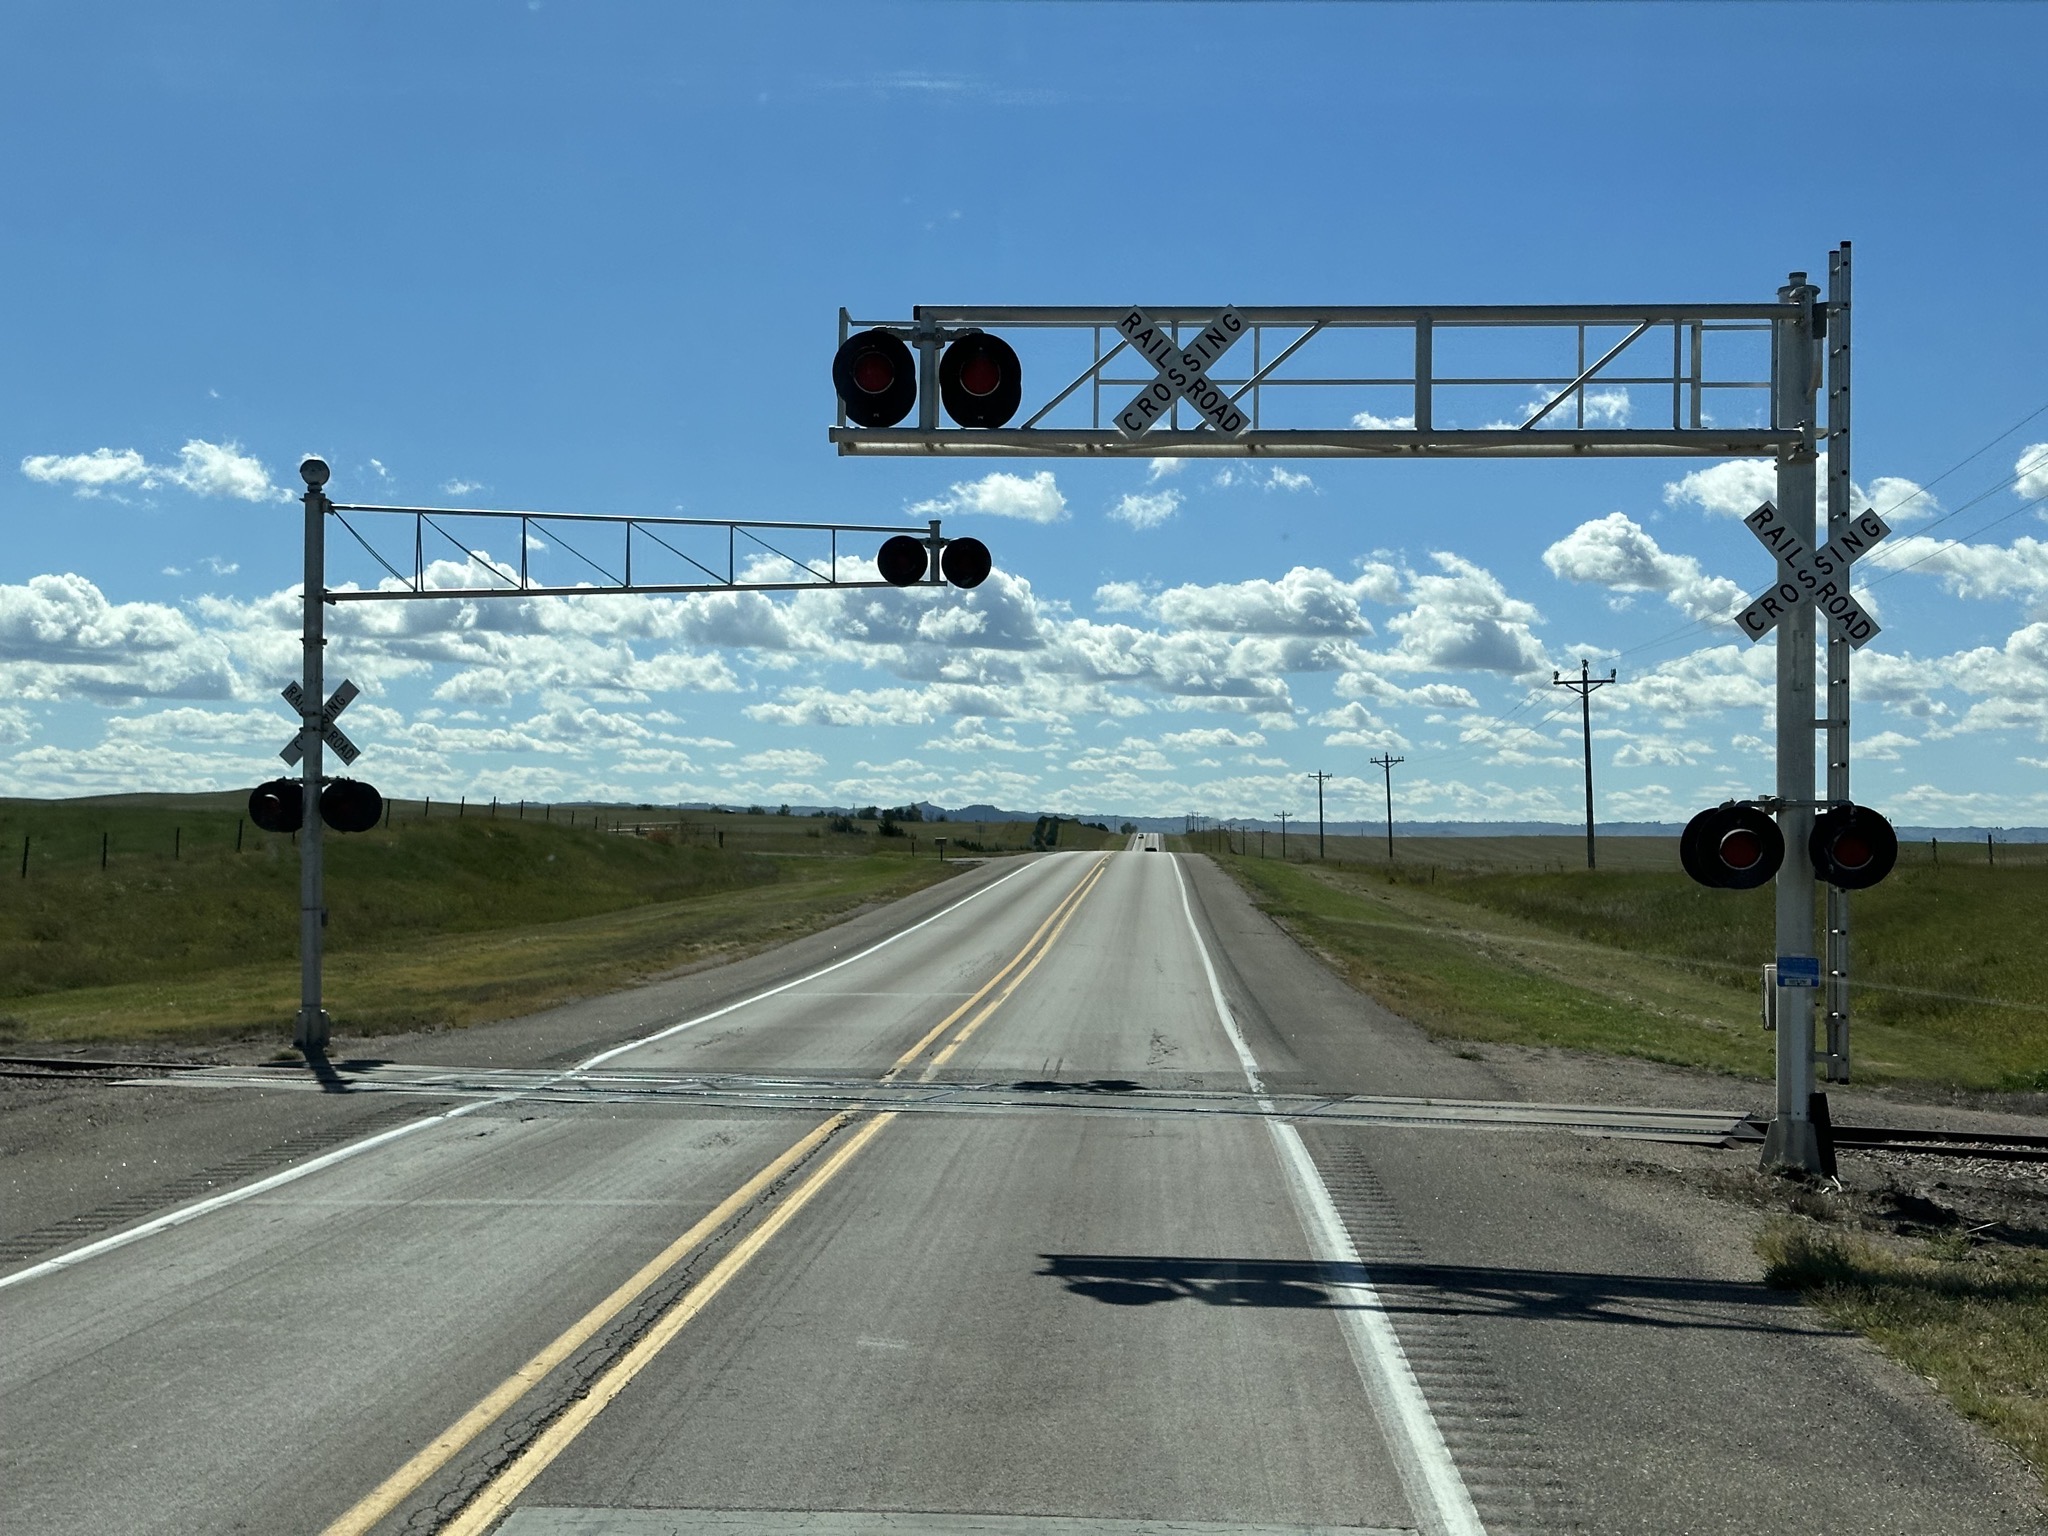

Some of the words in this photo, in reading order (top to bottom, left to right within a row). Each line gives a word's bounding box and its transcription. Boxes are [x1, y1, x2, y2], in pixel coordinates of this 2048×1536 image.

[1122, 312, 1171, 369] RAIL
[1186, 377, 1241, 432] ROAD
[1124, 313, 1241, 431] CROSSING
[1745, 518, 1881, 631] CROSSING
[1752, 508, 1803, 568] RAIL
[1815, 581, 1871, 640] ROAD
